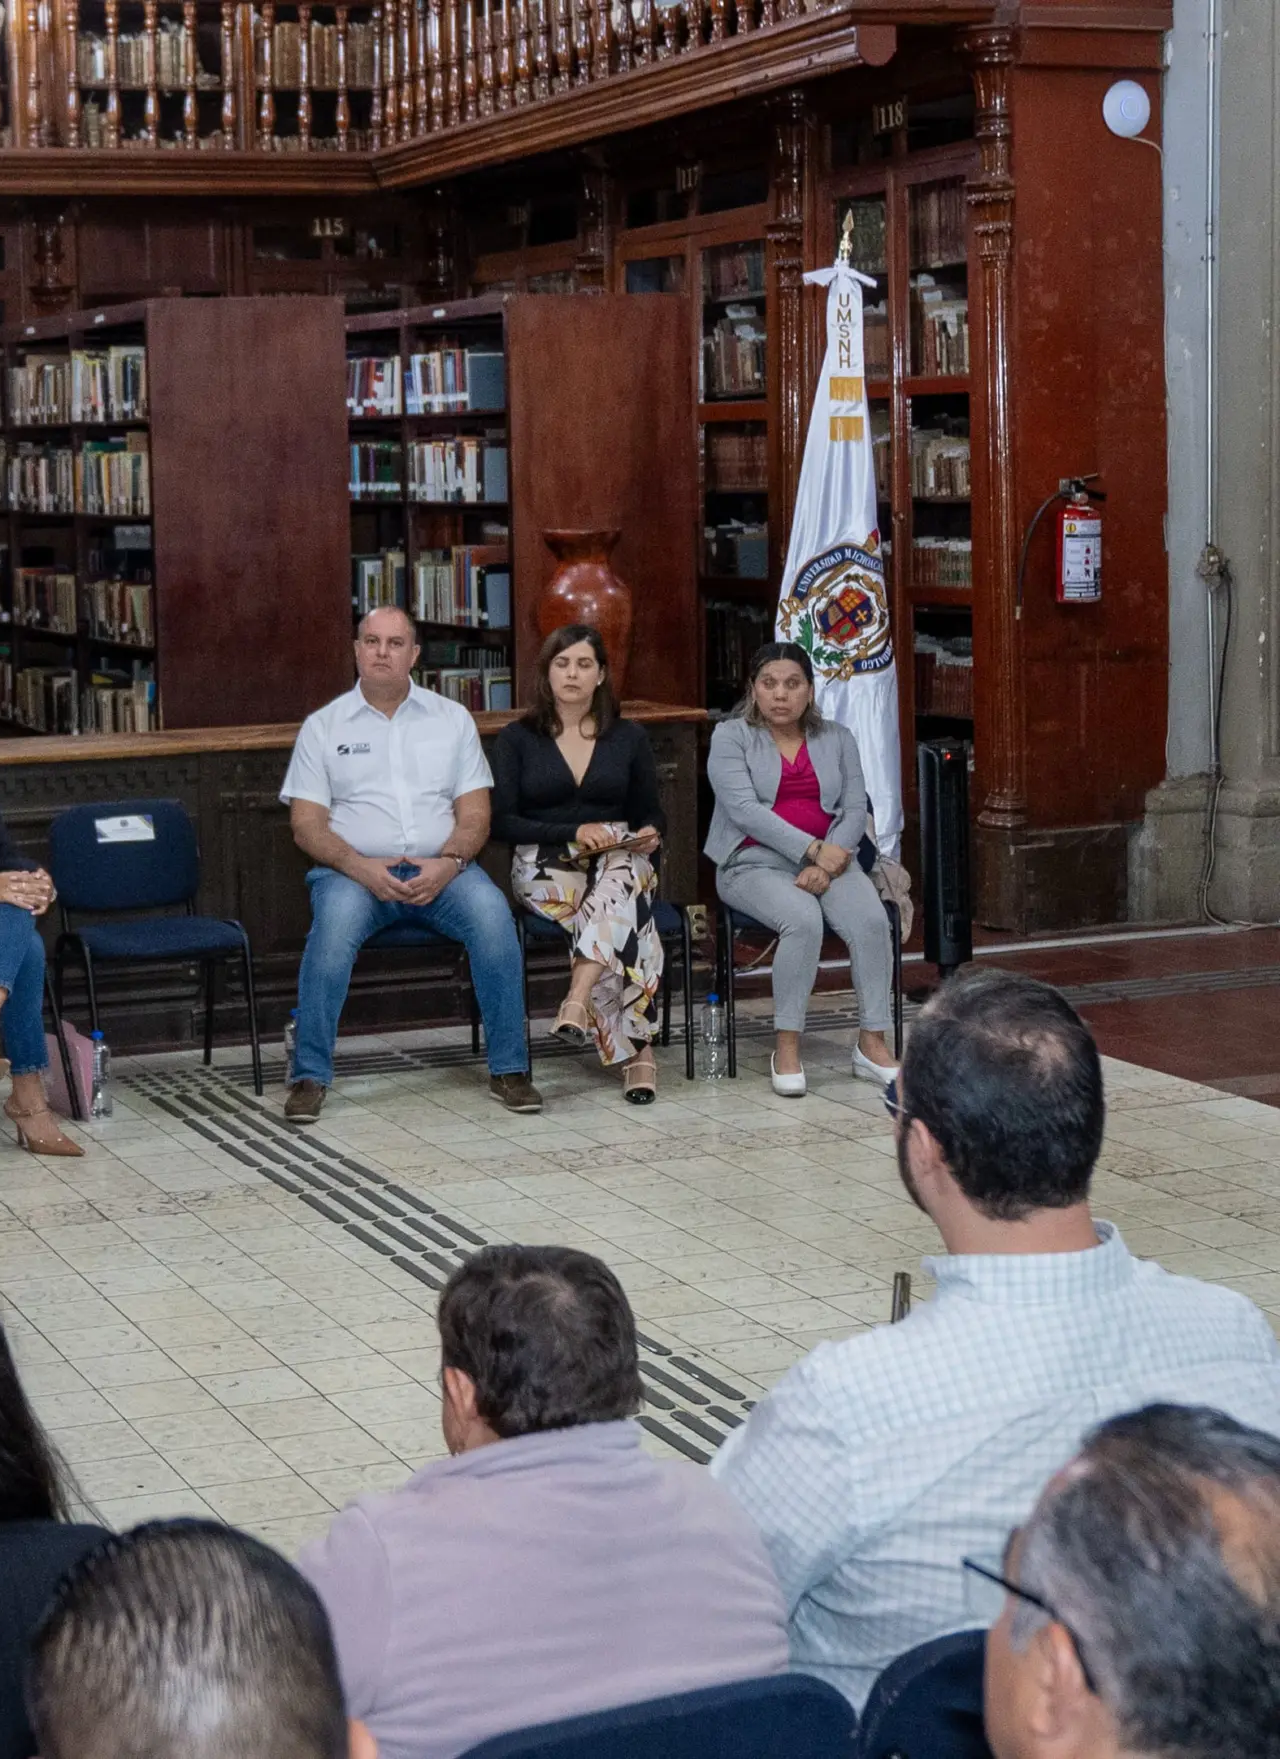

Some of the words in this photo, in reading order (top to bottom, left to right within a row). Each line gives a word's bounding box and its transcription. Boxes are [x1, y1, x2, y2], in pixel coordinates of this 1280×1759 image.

[880, 101, 903, 129] 118
[313, 218, 344, 236] 115
[837, 293, 852, 369] UMSNH
[797, 552, 842, 593] UNIVERSIDAD
